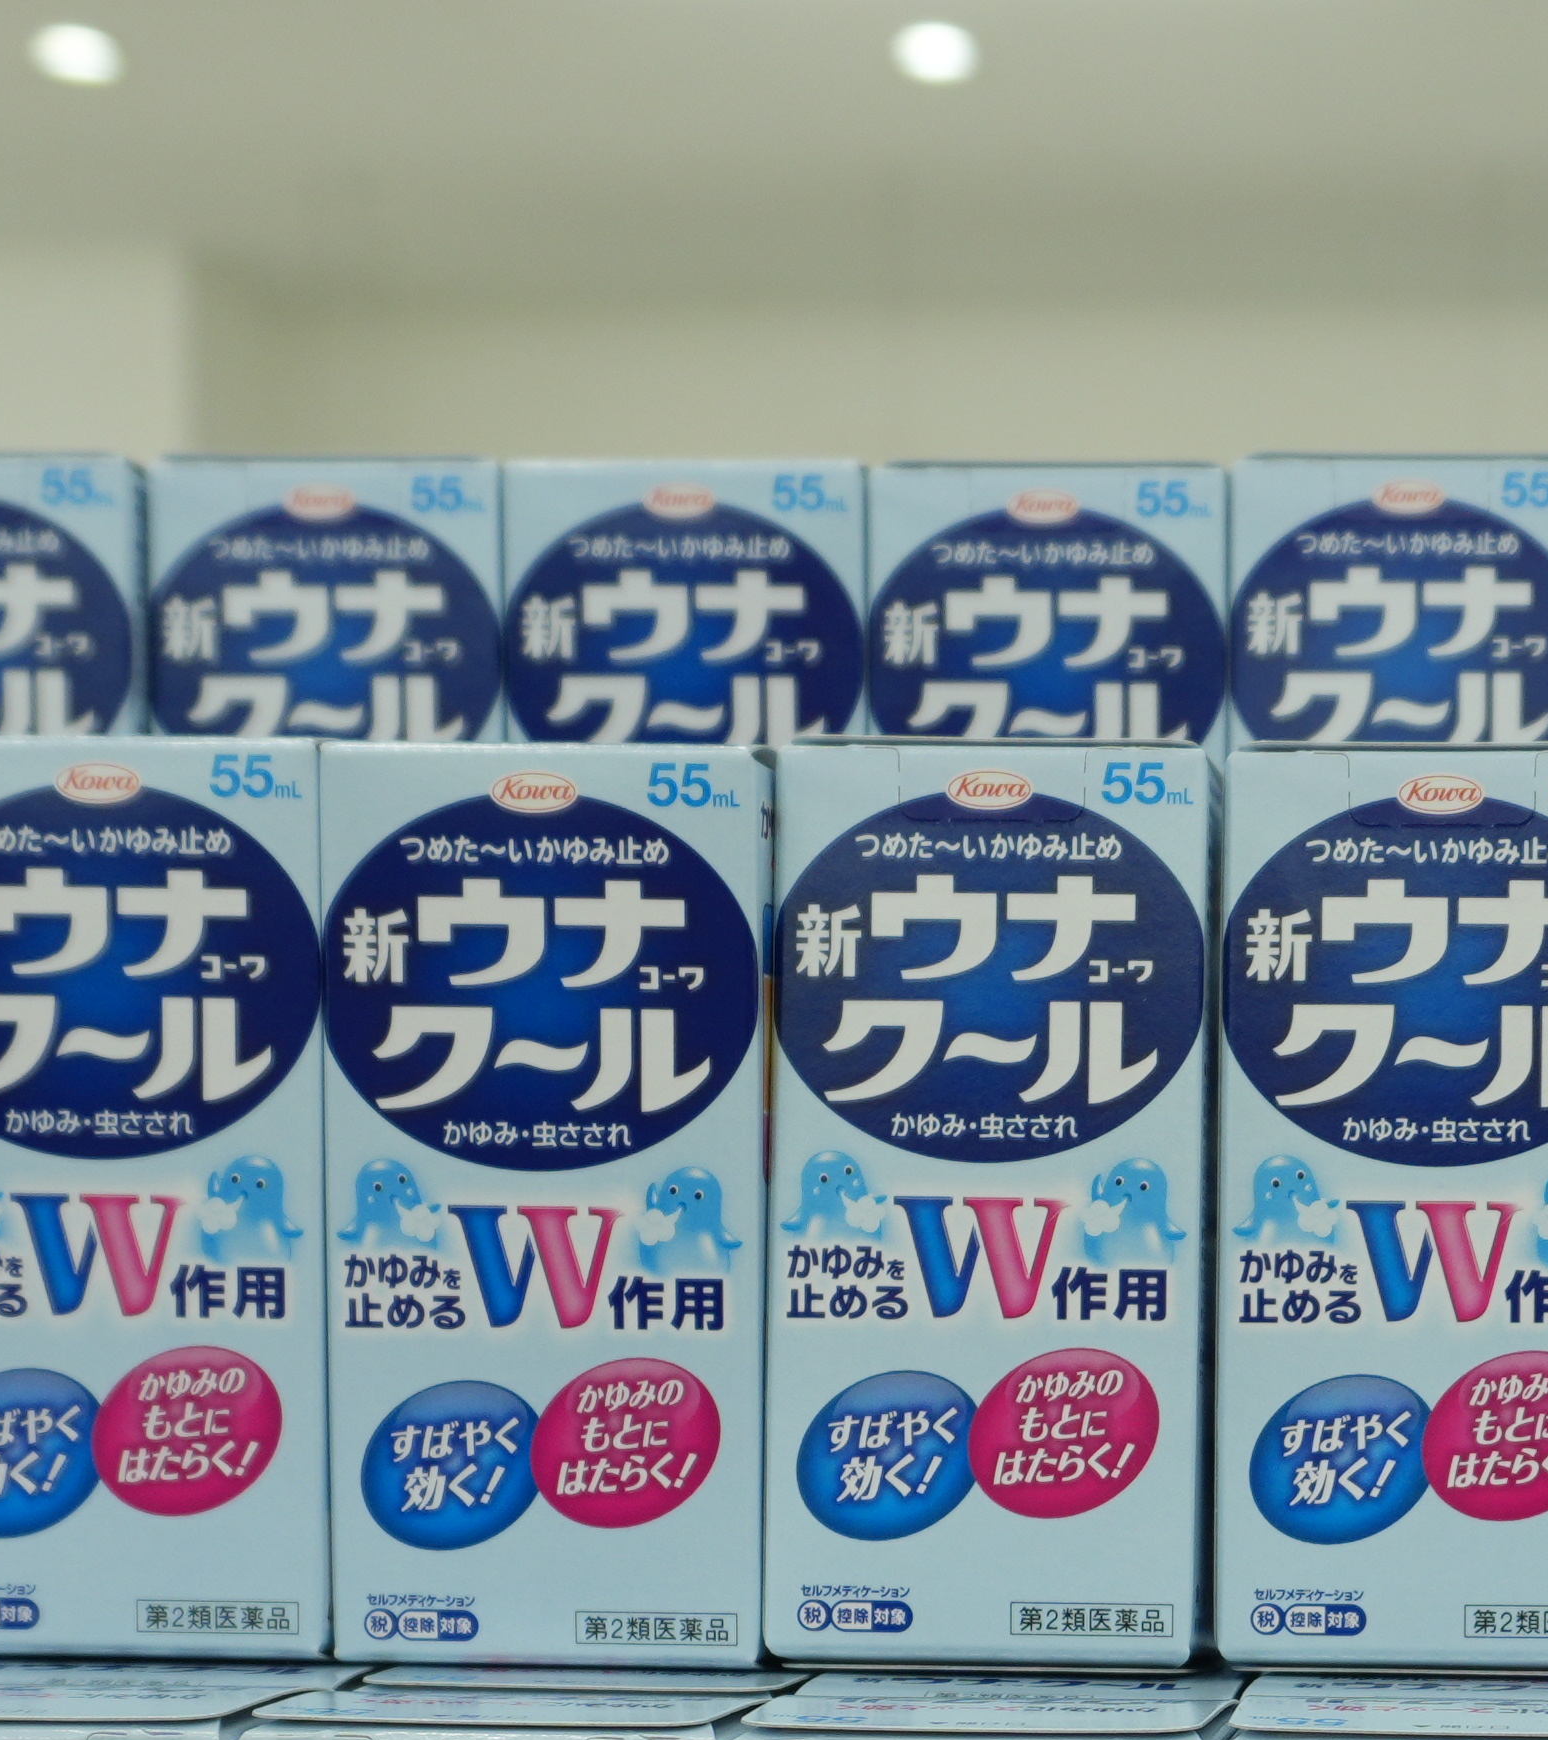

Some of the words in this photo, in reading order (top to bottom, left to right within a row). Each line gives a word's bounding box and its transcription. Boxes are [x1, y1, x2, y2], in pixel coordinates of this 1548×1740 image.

[585, 1616, 729, 1642] 第2類医薬品
